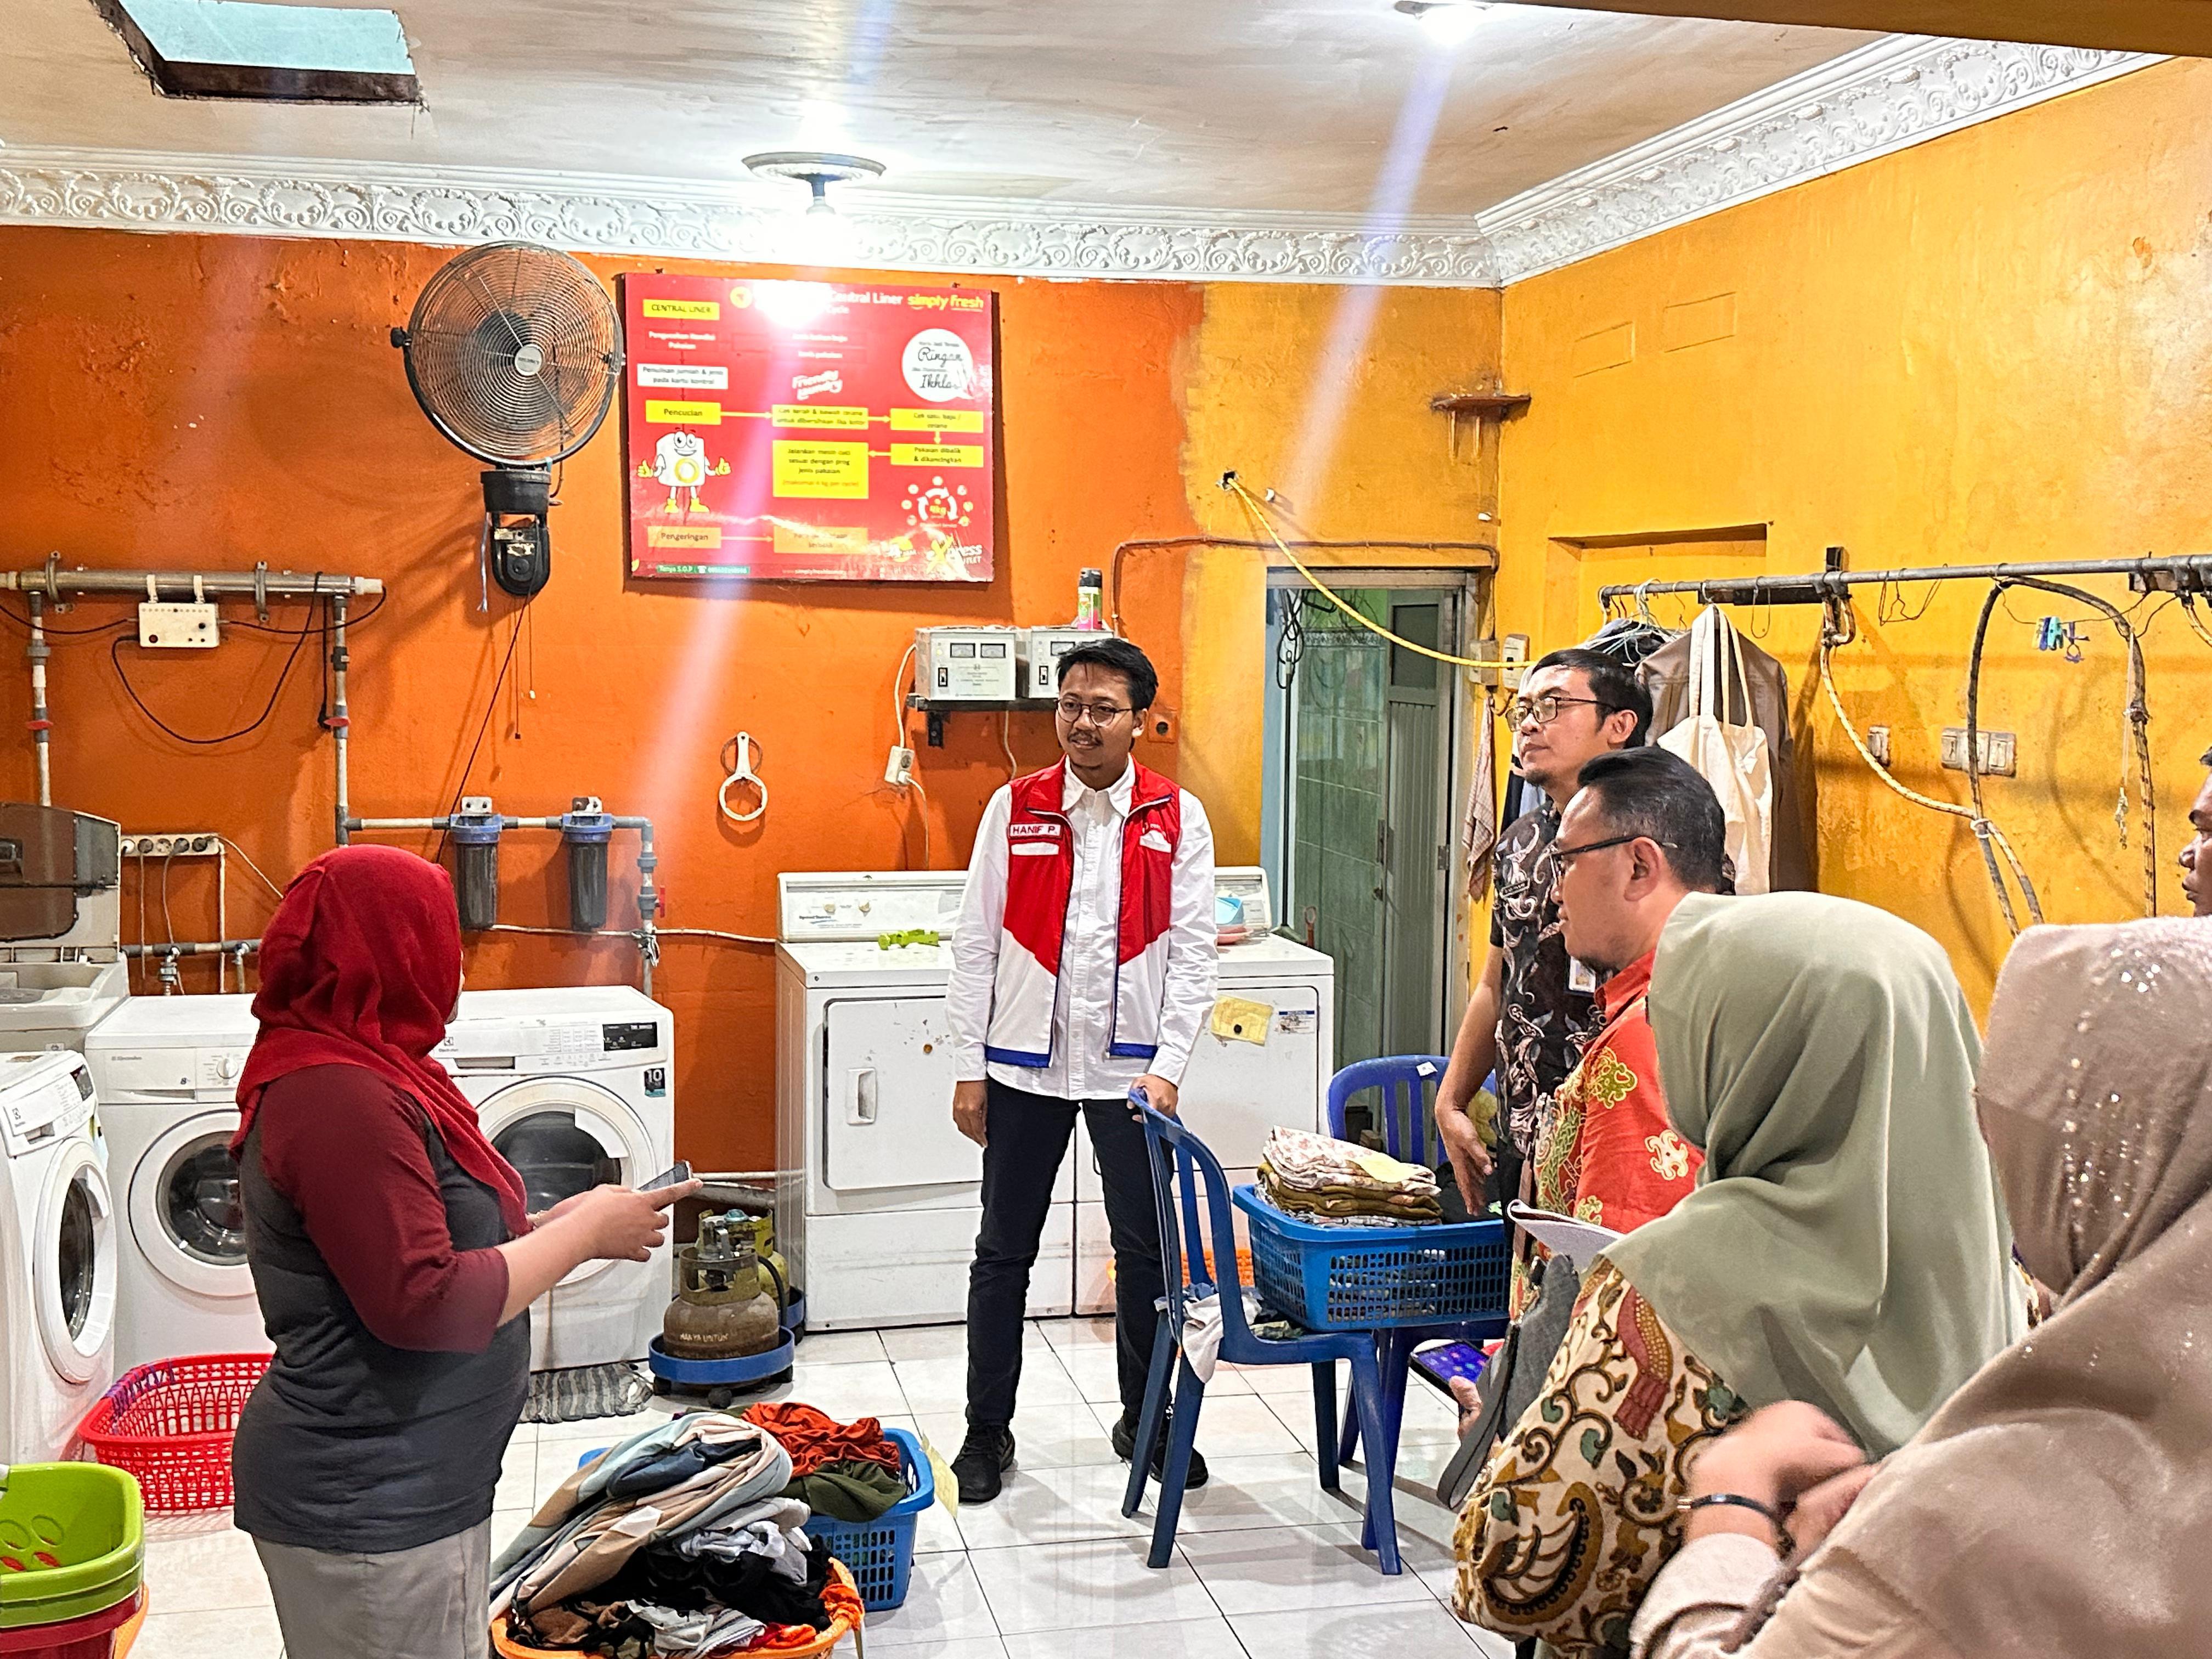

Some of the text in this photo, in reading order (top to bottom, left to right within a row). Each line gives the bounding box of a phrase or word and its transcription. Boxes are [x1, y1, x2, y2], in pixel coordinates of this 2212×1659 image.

[873, 292, 903, 304] Liner
[907, 294, 984, 311] simply fresh
[651, 304, 687, 312] CENTRAL
[918, 347, 963, 368] Ringan
[663, 408, 703, 416] Pencucian
[661, 532, 708, 542] Pengeringan
[1013, 826, 1043, 834] HANIF
[646, 1069, 663, 1083] 10
